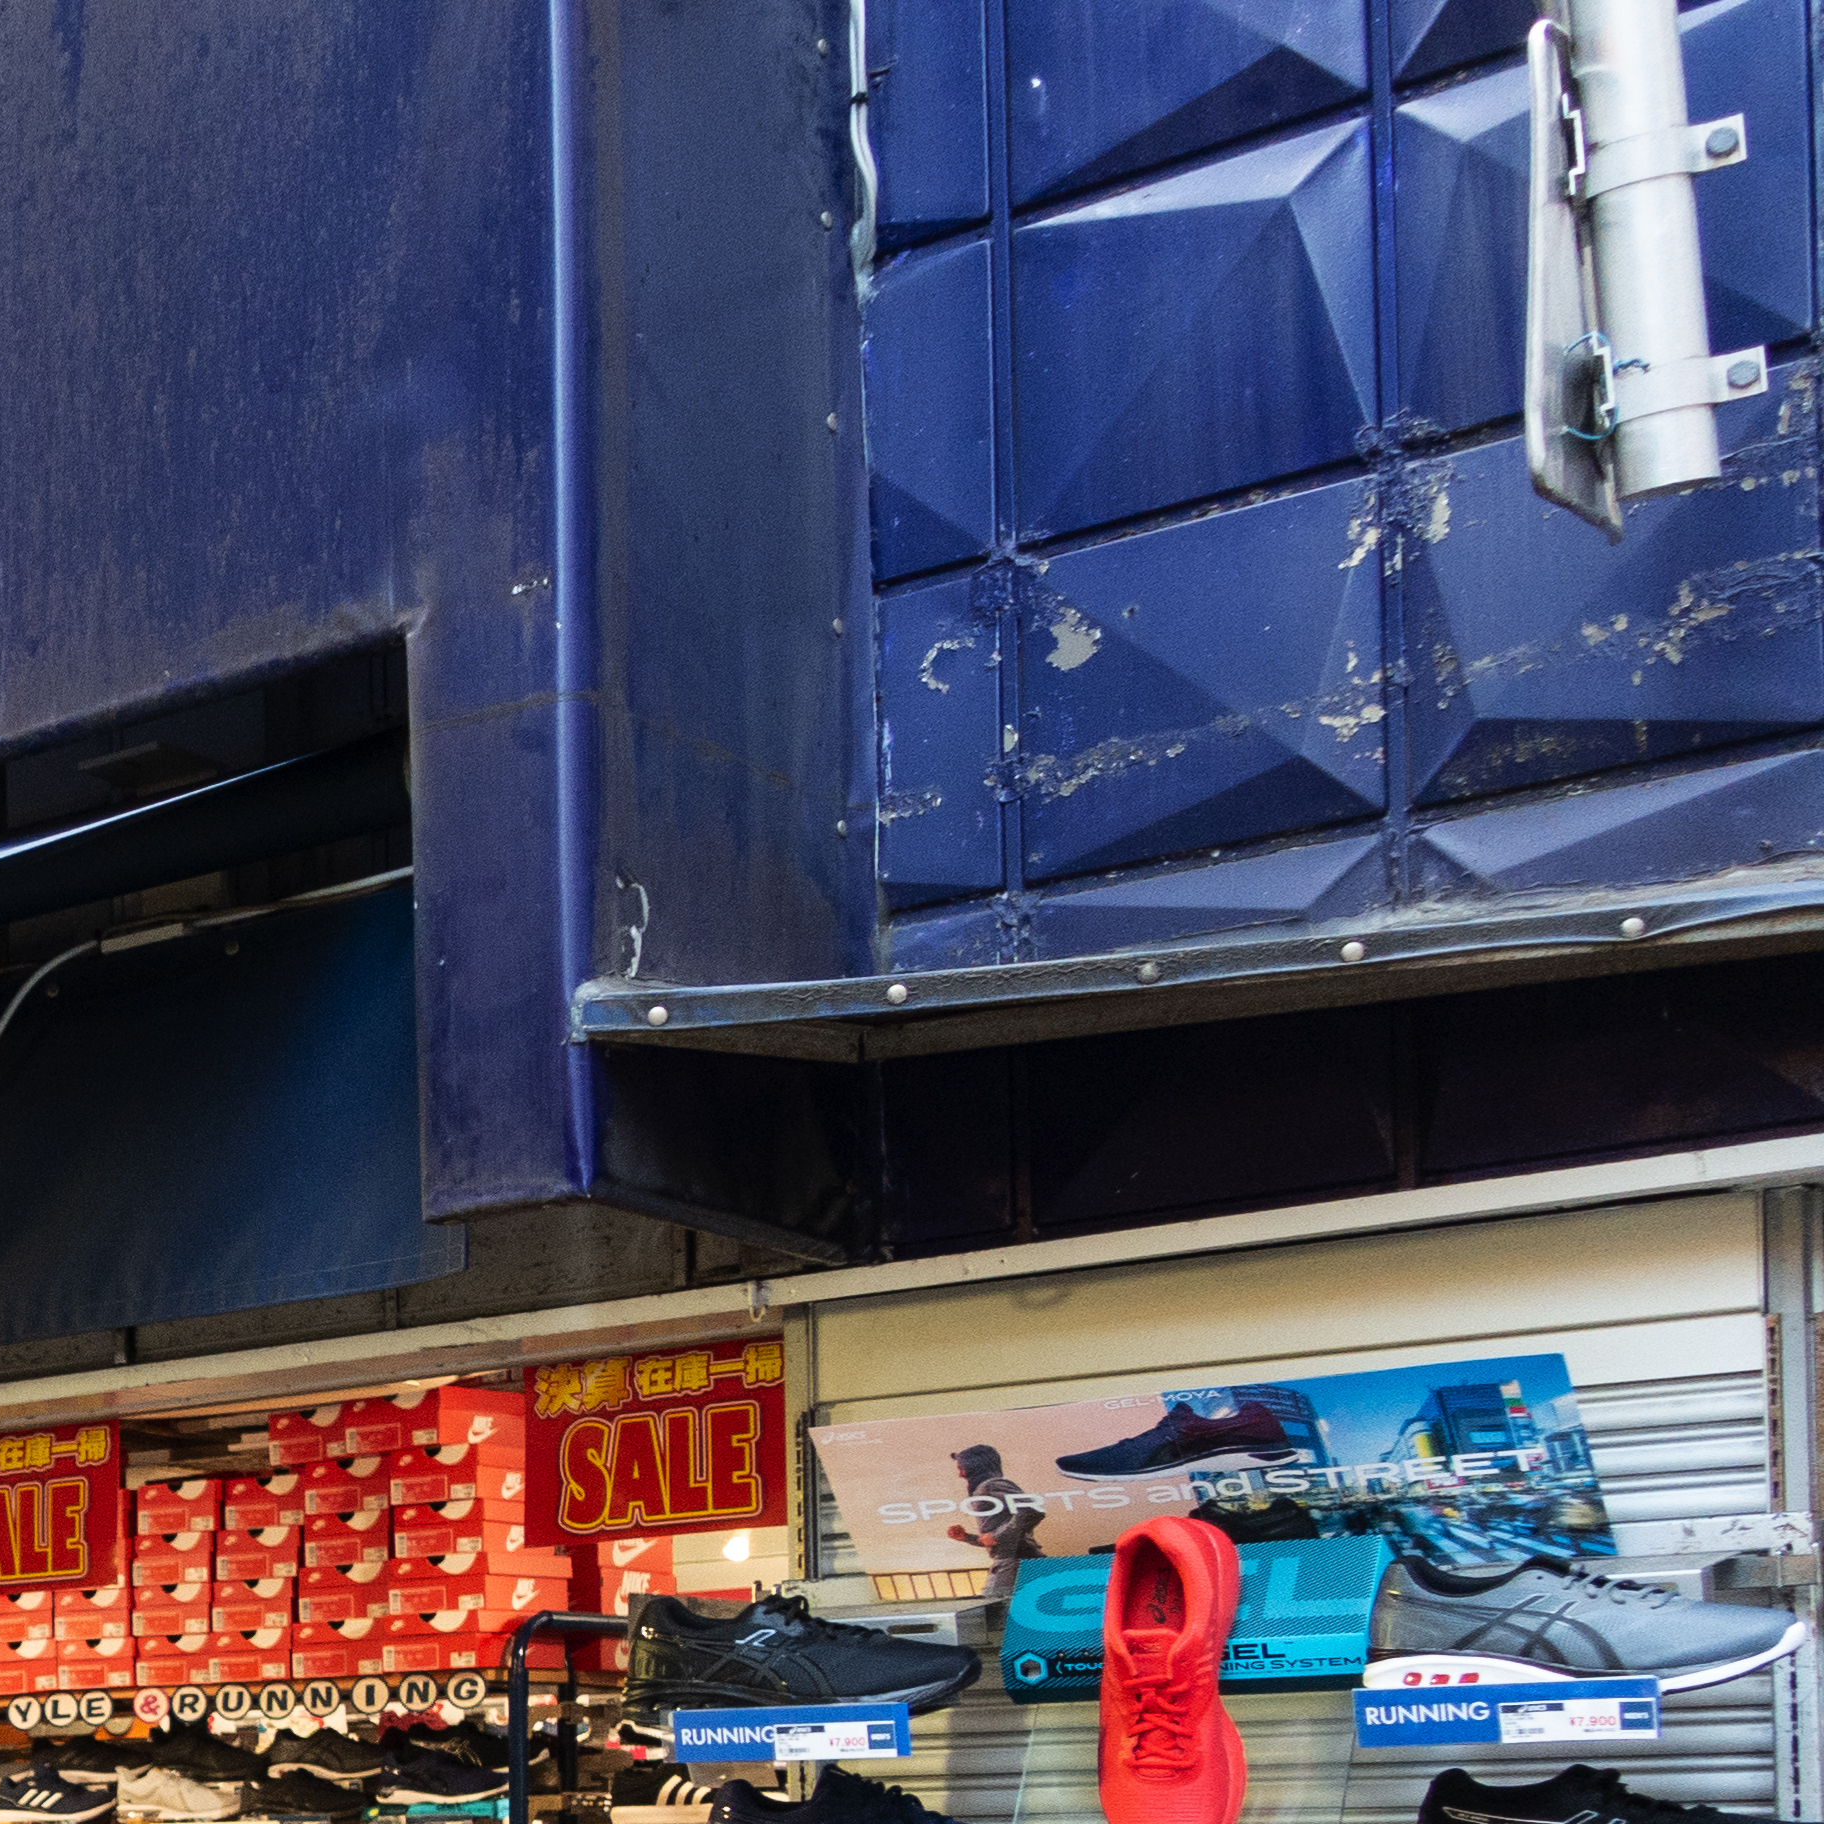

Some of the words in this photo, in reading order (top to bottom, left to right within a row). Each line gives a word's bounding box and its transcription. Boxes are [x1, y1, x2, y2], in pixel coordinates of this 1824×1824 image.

[535, 1361, 629, 1414] 決算
[636, 1342, 783, 1398] 在庫一掃
[561, 1402, 761, 1531] SALE
[877, 1486, 1130, 1525] SPORTS
[1147, 1466, 1253, 1498] and
[1266, 1448, 1548, 1494] STREET
[681, 1726, 776, 1748] RUNNING
[1366, 1702, 1490, 1725] RUNNING
